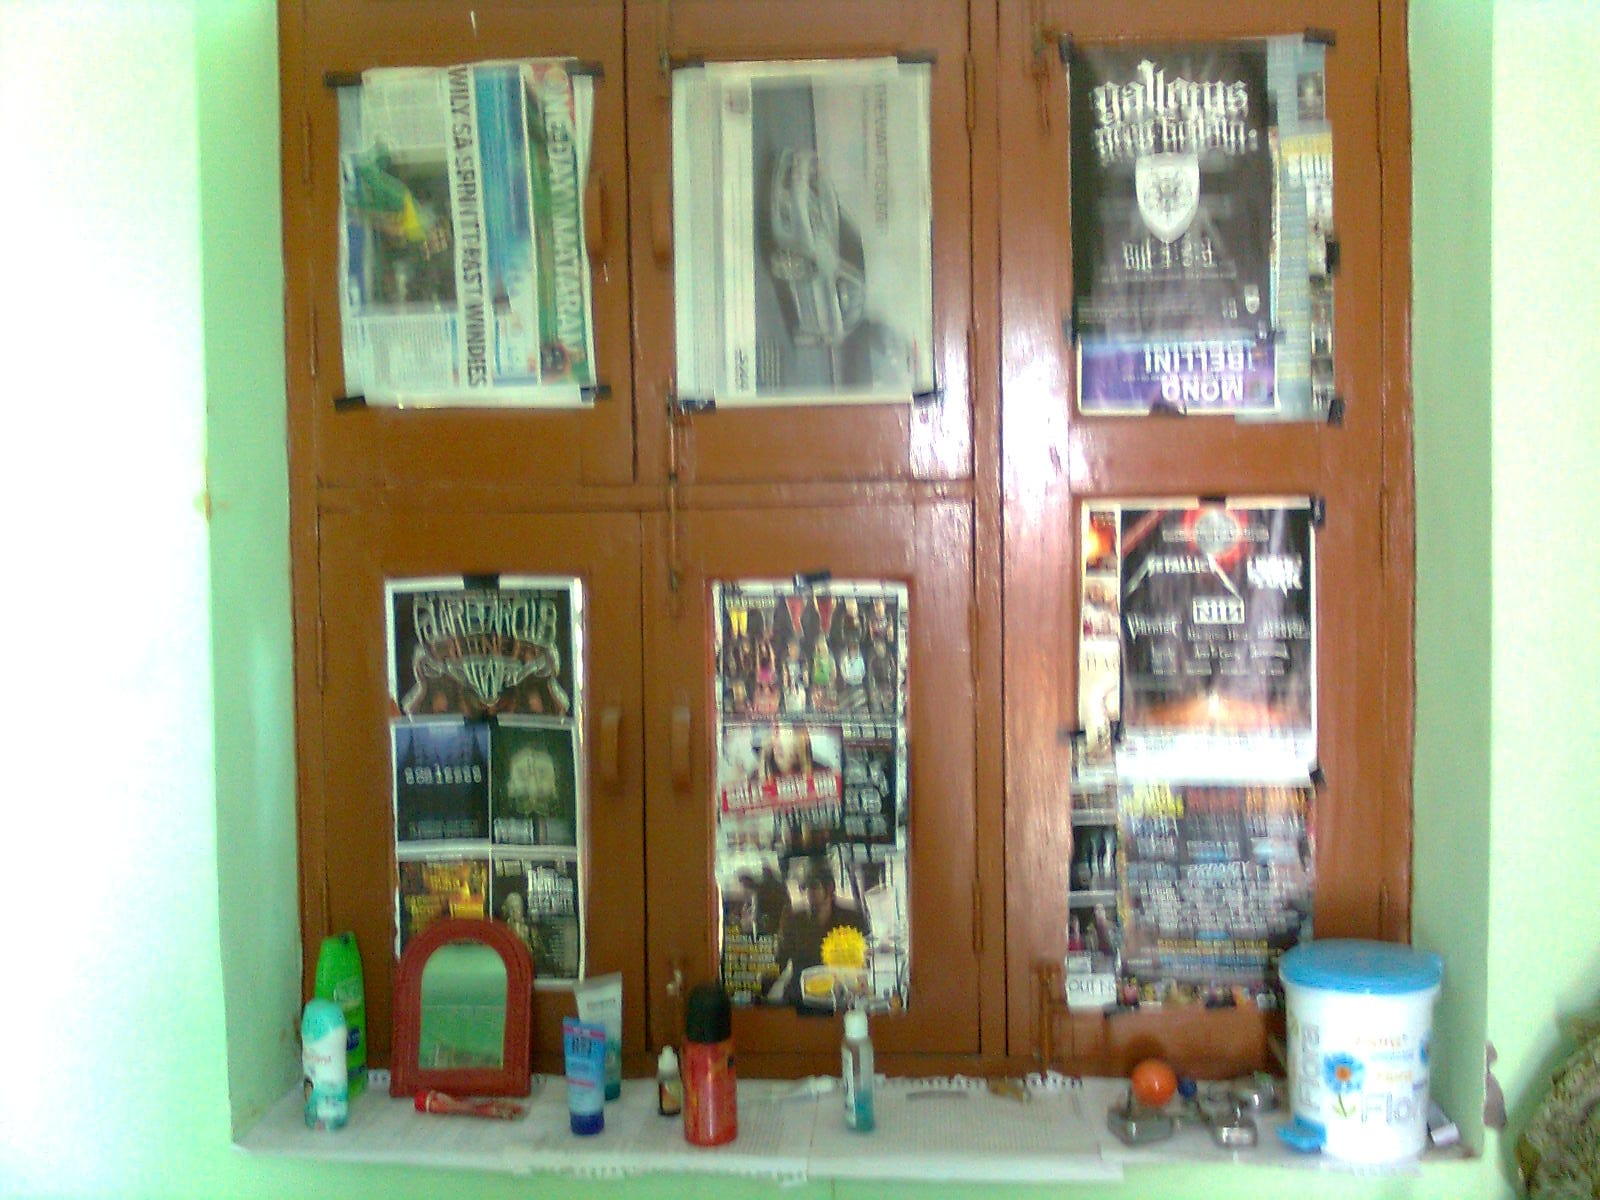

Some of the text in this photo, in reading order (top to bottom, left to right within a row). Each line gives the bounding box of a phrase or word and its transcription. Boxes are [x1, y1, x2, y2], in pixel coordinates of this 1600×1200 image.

[447, 66, 471, 118] WILY
[451, 122, 473, 150] SA
[465, 303, 487, 388] WINDIES
